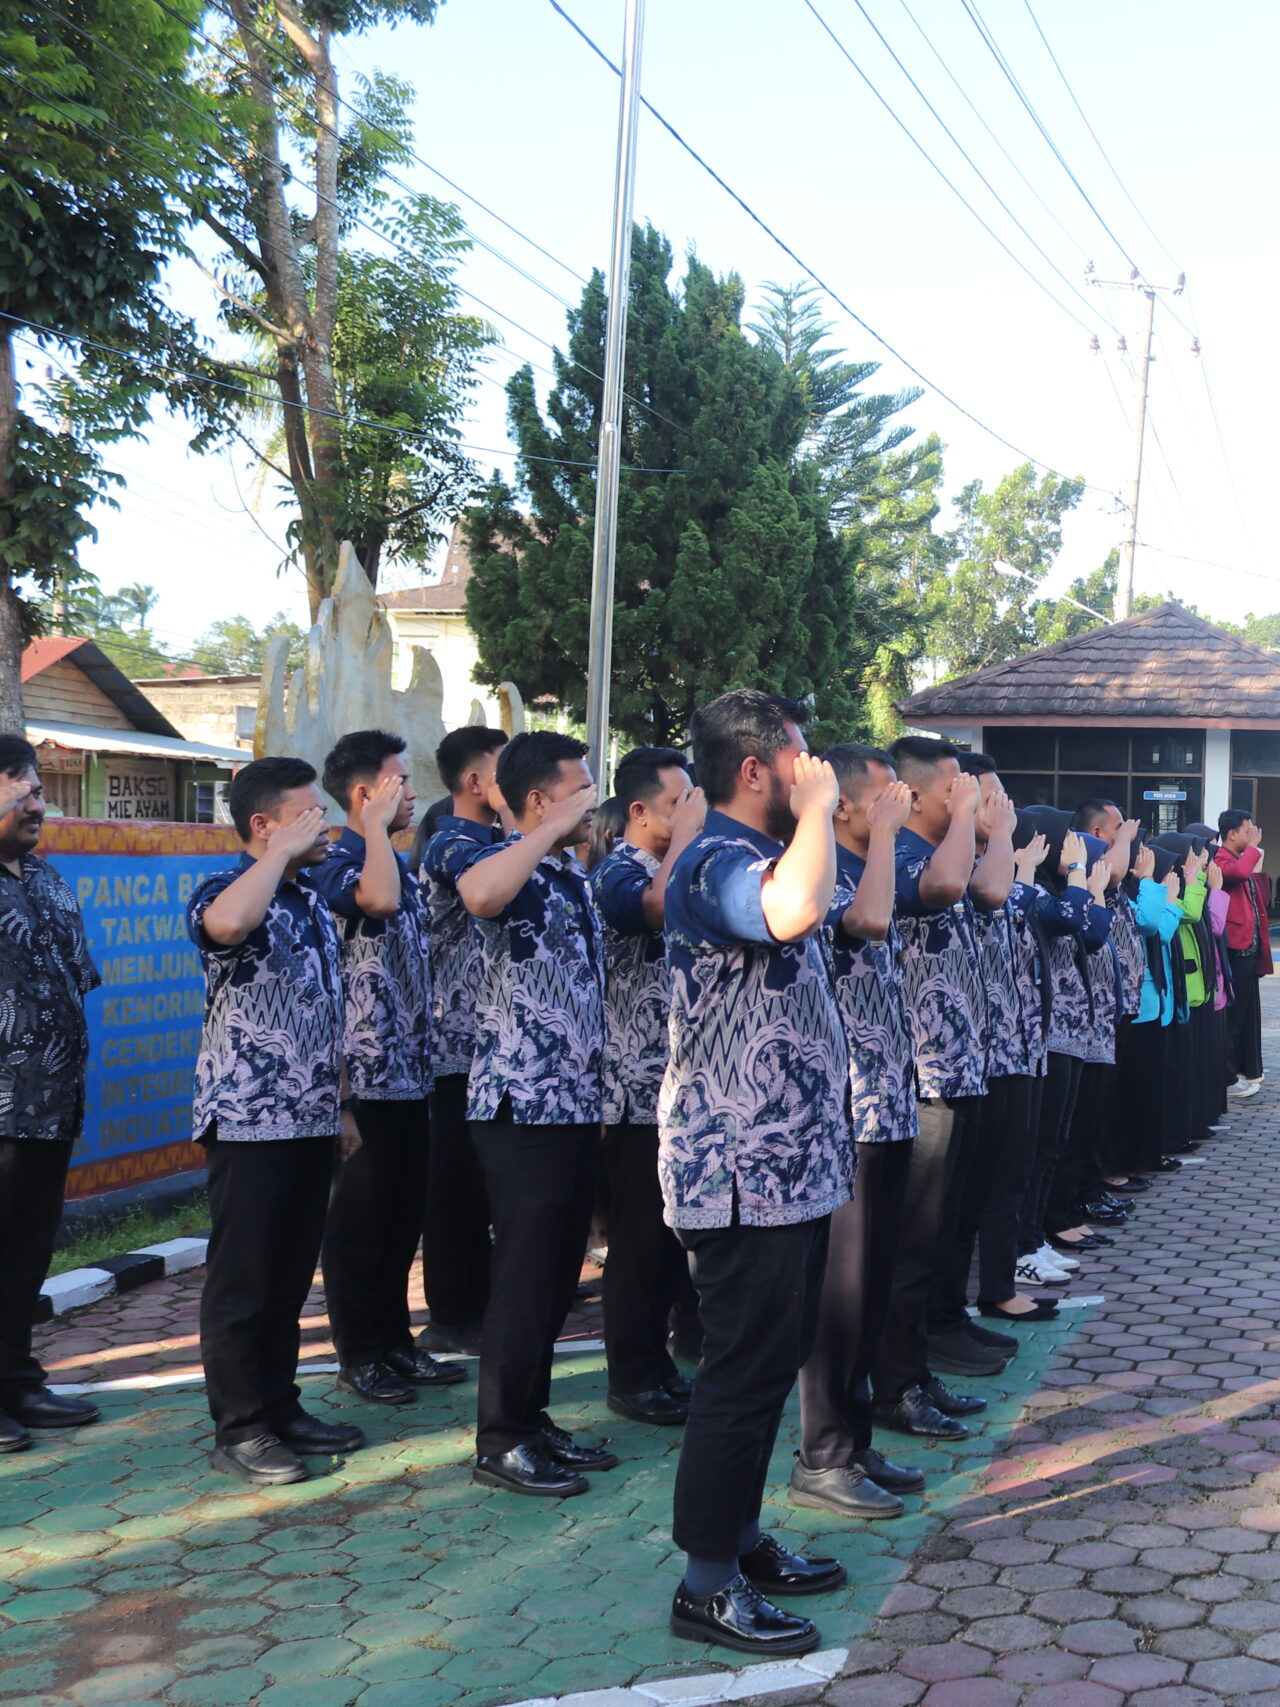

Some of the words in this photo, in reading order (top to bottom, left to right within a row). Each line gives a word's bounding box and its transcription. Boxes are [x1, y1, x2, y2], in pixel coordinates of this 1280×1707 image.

[109, 776, 168, 796] BAKSO
[108, 800, 132, 818] MIE
[135, 800, 170, 818] AYAM
[77, 874, 169, 910] PANCA
[101, 913, 189, 947] TAKWA
[102, 951, 204, 987] MENJUN
[103, 990, 206, 1027] KEHORM
